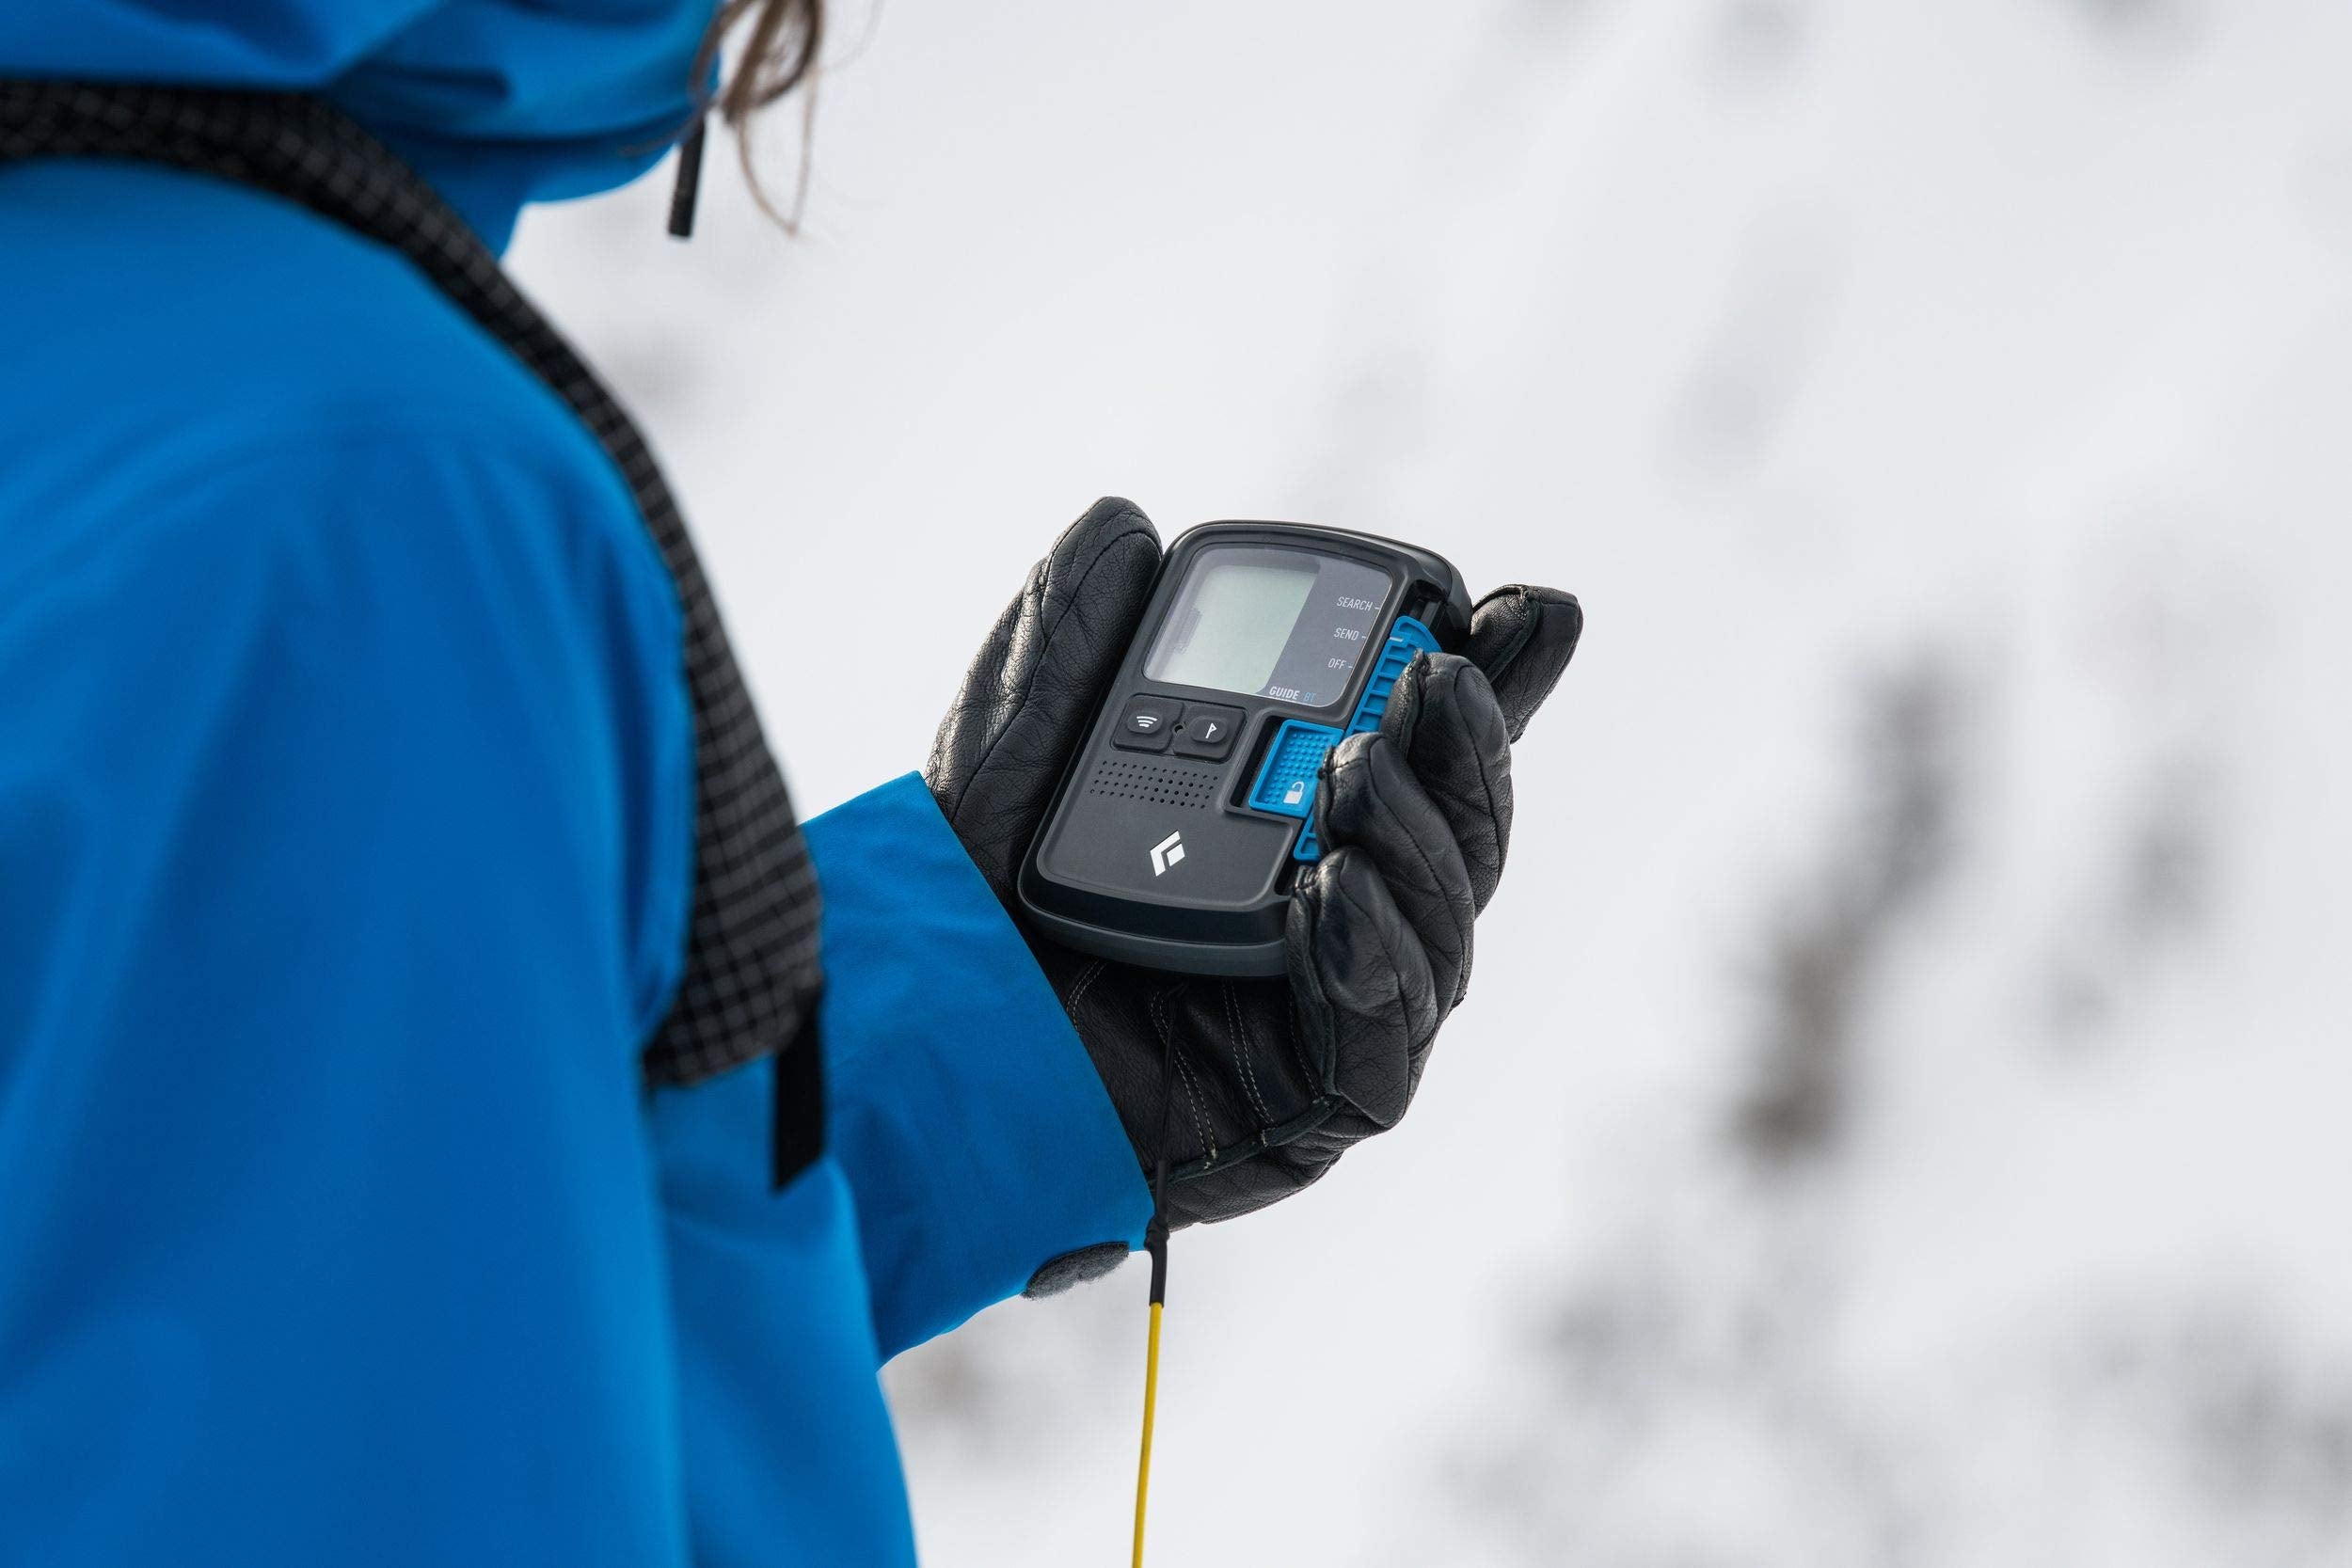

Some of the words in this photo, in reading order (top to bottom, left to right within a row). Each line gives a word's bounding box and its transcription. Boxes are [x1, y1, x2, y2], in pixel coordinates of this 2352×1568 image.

[1336, 596, 1374, 611] SEARCH
[1333, 626, 1359, 641] SEND
[1327, 657, 1347, 670] OFF
[1269, 686, 1300, 701] GUIDE
